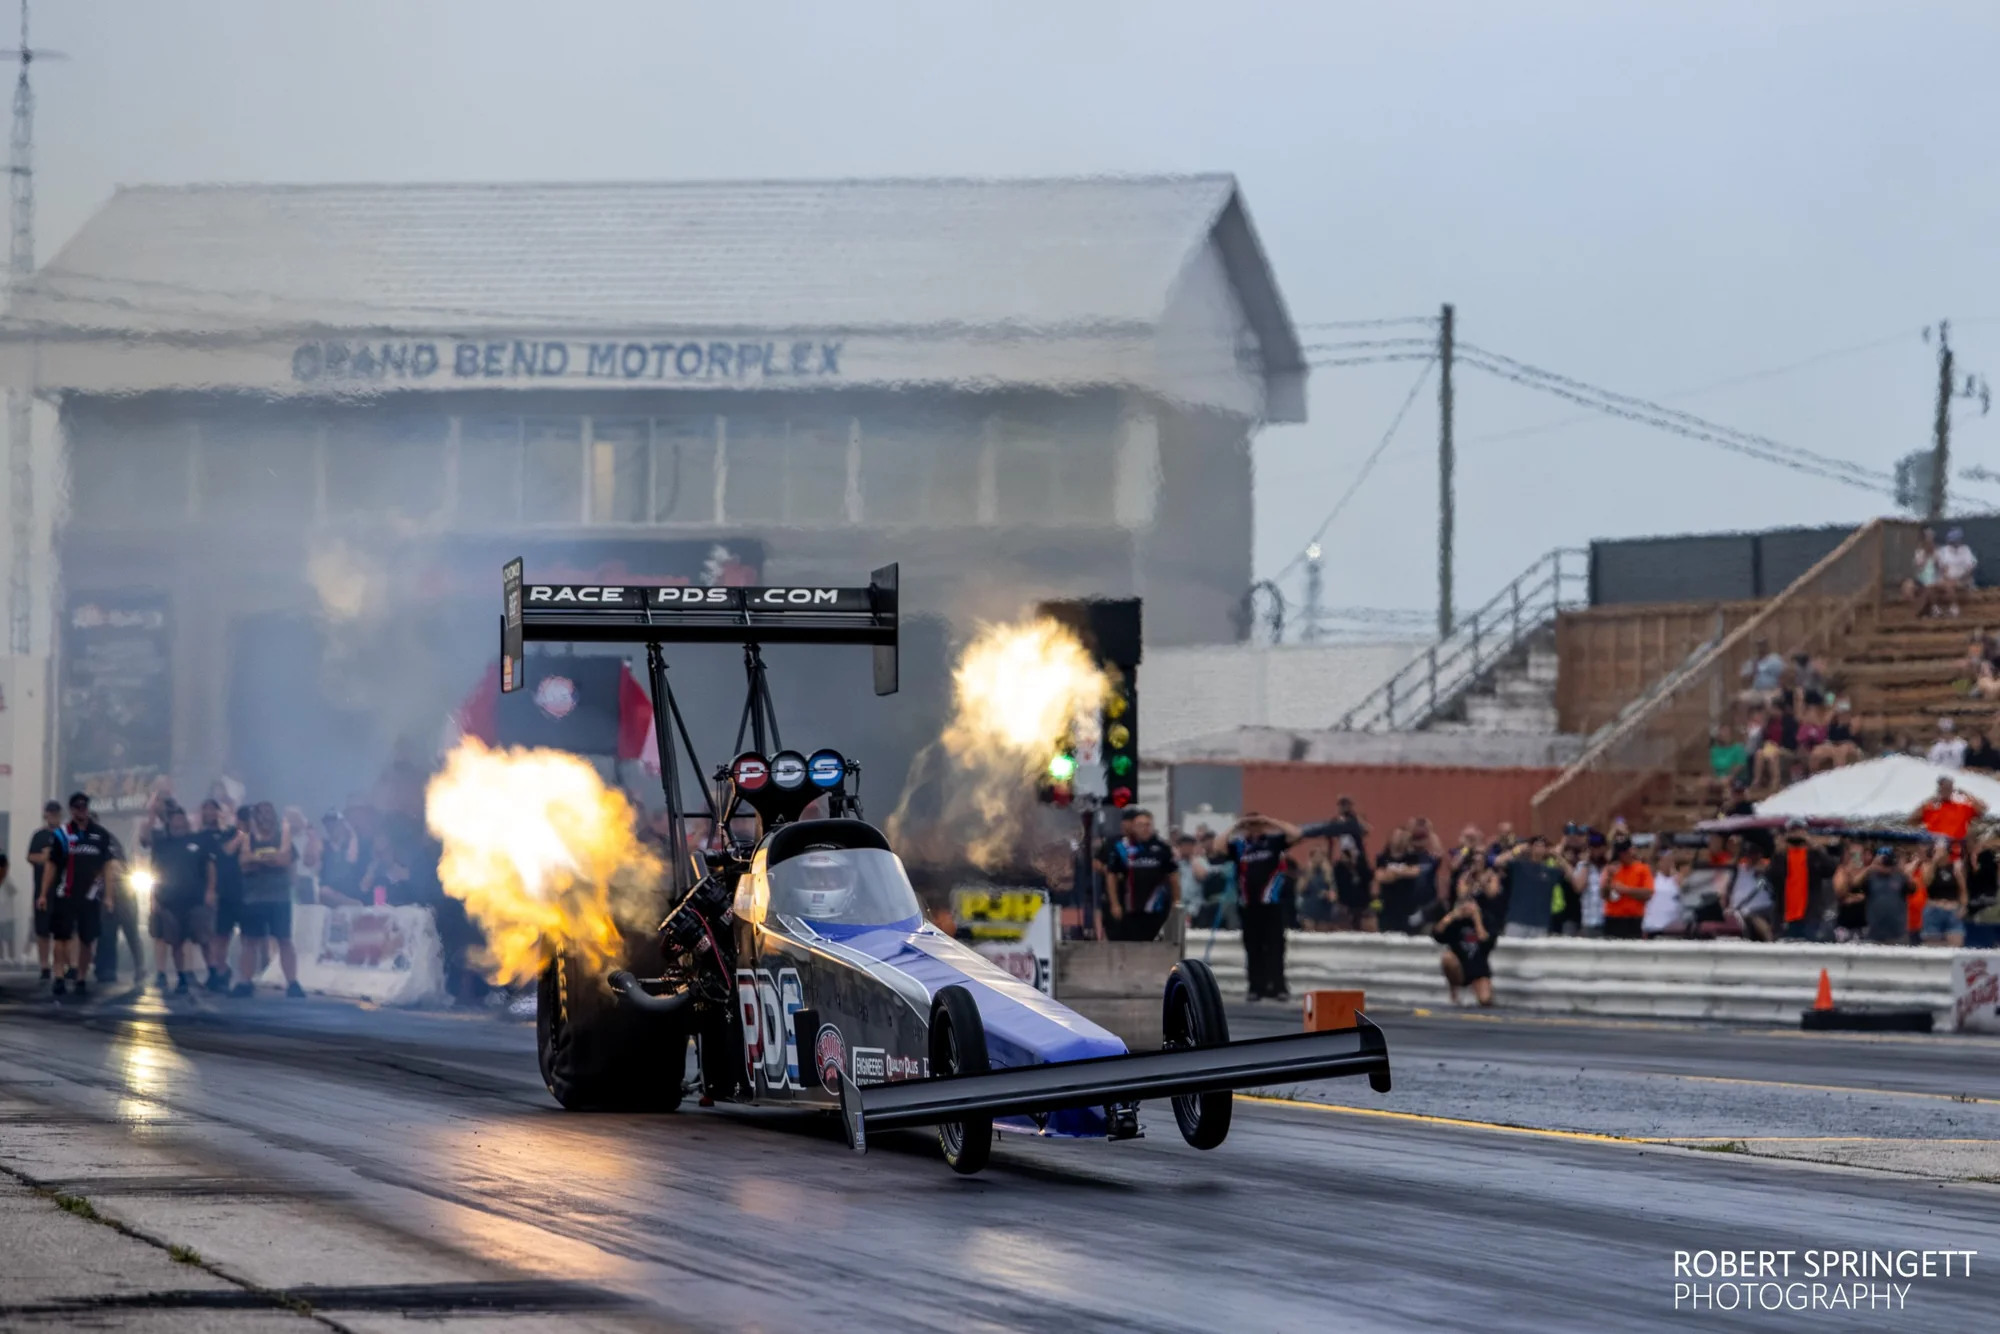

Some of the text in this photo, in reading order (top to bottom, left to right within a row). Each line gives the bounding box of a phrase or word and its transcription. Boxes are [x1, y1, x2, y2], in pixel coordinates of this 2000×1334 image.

[453, 341, 569, 377] BEND
[586, 338, 843, 378] MOTORPLEX
[530, 586, 839, 604] RACE PDS .COM
[739, 759, 839, 783] PDS
[736, 967, 807, 1090] PDS
